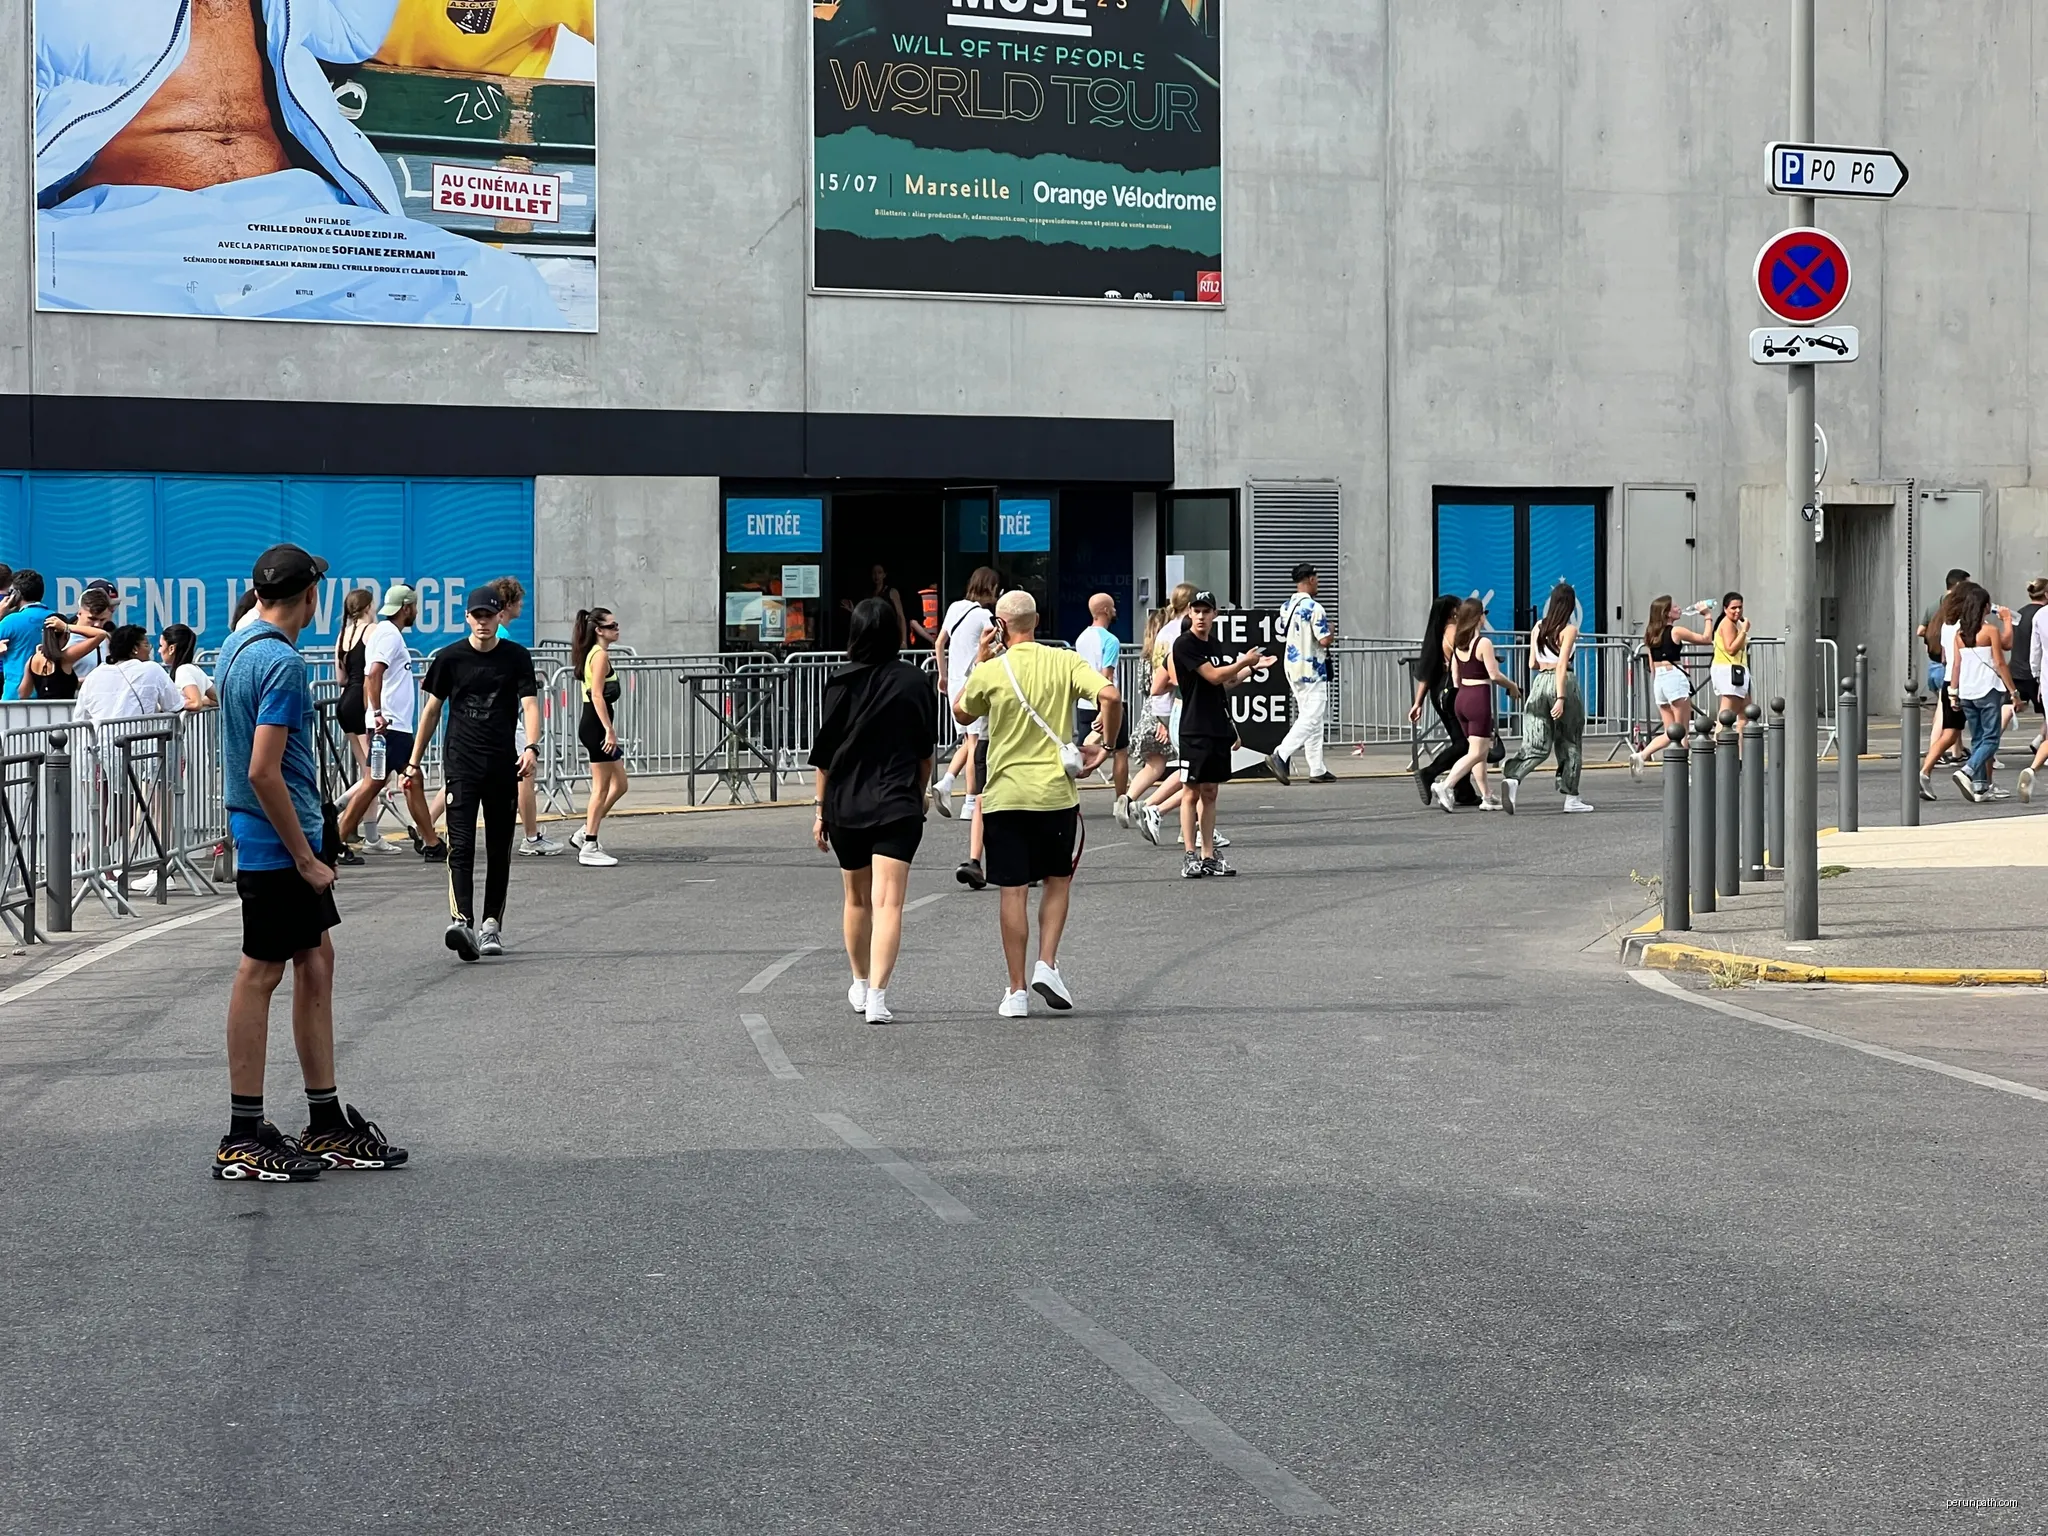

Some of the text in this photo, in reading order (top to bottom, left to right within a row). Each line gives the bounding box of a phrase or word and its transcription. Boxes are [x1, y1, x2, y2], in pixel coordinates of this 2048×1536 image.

[892, 33, 1145, 70] WILL OF THE PEOPLE
[829, 58, 1202, 132] WORLD TOUR
[1851, 161, 1875, 184] P6
[441, 173, 552, 196] AU CINÉMA LE
[819, 173, 1217, 212] 15/07 Marseille Orange Vélodrome
[440, 190, 552, 215] 26 JUILLET
[247, 223, 407, 240] CYRILLE DROUX & CLAUDE ZIDI JR.
[305, 216, 317, 224] UN
[318, 217, 339, 225] FILM
[218, 241, 436, 260] AVEC LA PARTICIPATION DE SOFIANE ZERMANI
[183, 255, 217, 264] SCÉNARIO
[228, 258, 265, 267] NORDINE
[290, 261, 318, 269] KARIM
[341, 264, 373, 272] CYRILLE
[410, 268, 440, 276] CLAUDE
[1200, 280, 1220, 293] RTL2
[747, 510, 801, 535] ENTRÉE
